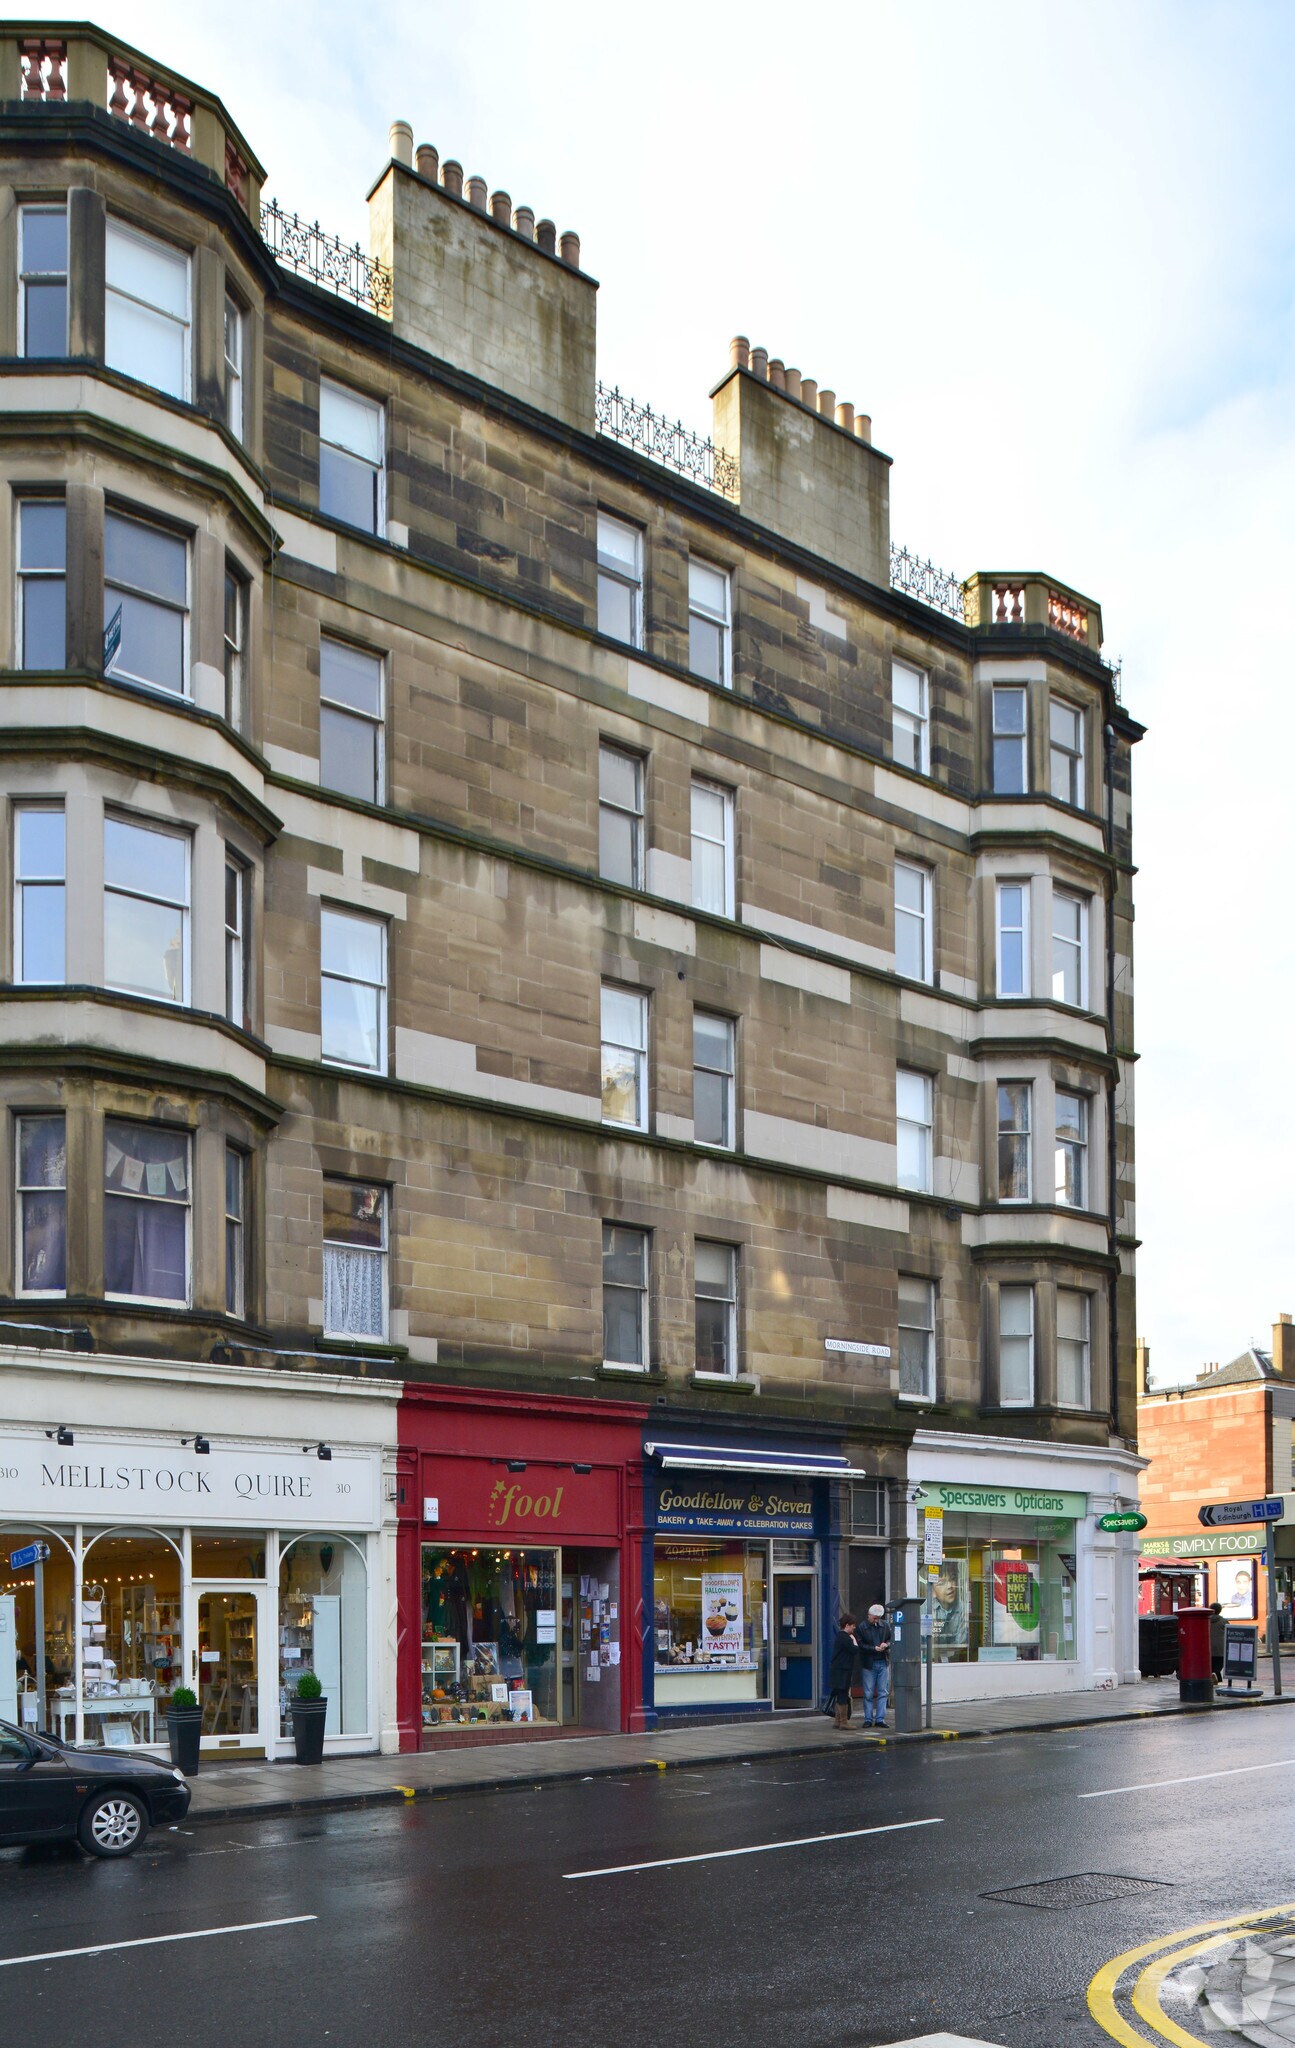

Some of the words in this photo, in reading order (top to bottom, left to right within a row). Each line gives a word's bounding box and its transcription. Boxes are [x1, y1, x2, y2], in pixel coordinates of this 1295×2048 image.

[826, 1341, 869, 1353] MORNINGSIDE
[871, 1346, 890, 1355] ROAD
[41, 1463, 211, 1493] MELLSTOCK
[234, 1473, 312, 1501] QUIRE
[335, 1483, 352, 1494] 310
[659, 1488, 745, 1512] Goodfellow
[747, 1494, 764, 1512] &
[764, 1495, 812, 1516] Steven
[939, 1487, 1006, 1508] Specsavers
[1014, 1492, 1064, 1512] Opticians
[495, 1485, 564, 1526] fool
[1223, 1505, 1243, 1513] Royal
[1217, 1512, 1252, 1522] Edinburgh
[657, 1515, 687, 1525] BAKERY
[695, 1517, 735, 1527] TAKE-AWAY
[743, 1520, 789, 1528] CELEBRATION
[790, 1521, 813, 1530] CAKES
[1102, 1518, 1139, 1528] Specsavers
[1172, 1538, 1217, 1553] SIMPLY
[1219, 1535, 1258, 1550] FOOD
[1143, 1547, 1170, 1555] SPENCER
[1006, 1573, 1028, 1583] FREE
[704, 1587, 739, 1595] HALLOWEEN
[1006, 1583, 1026, 1593] NHS
[1007, 1593, 1024, 1602] EYE
[1007, 1602, 1031, 1612] EXAM
[896, 1611, 902, 1622] P
[706, 1641, 740, 1650] TASTY!
